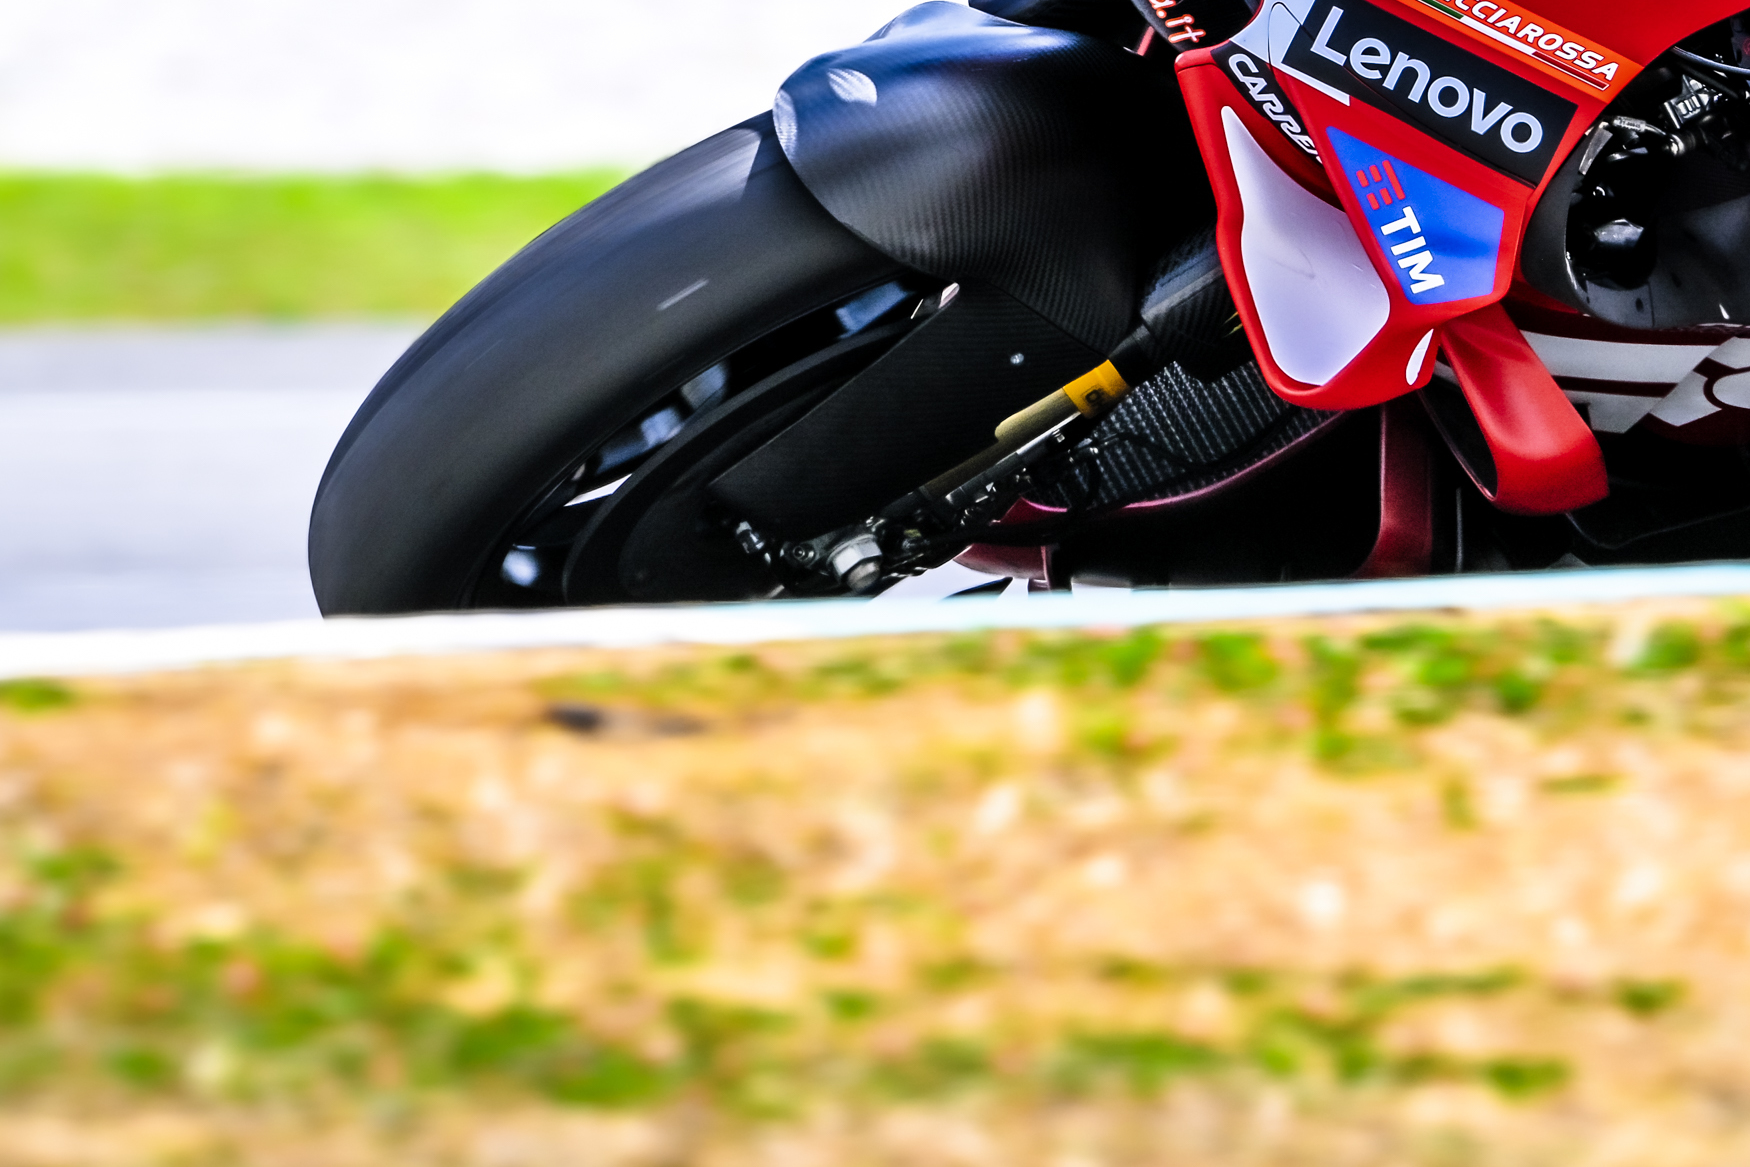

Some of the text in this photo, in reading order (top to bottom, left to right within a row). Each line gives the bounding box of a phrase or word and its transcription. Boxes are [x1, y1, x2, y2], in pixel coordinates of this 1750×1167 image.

[1228, 53, 1323, 164] CARRE
[1310, 5, 1544, 153] Lenovo
[1381, 207, 1445, 294] TIM
